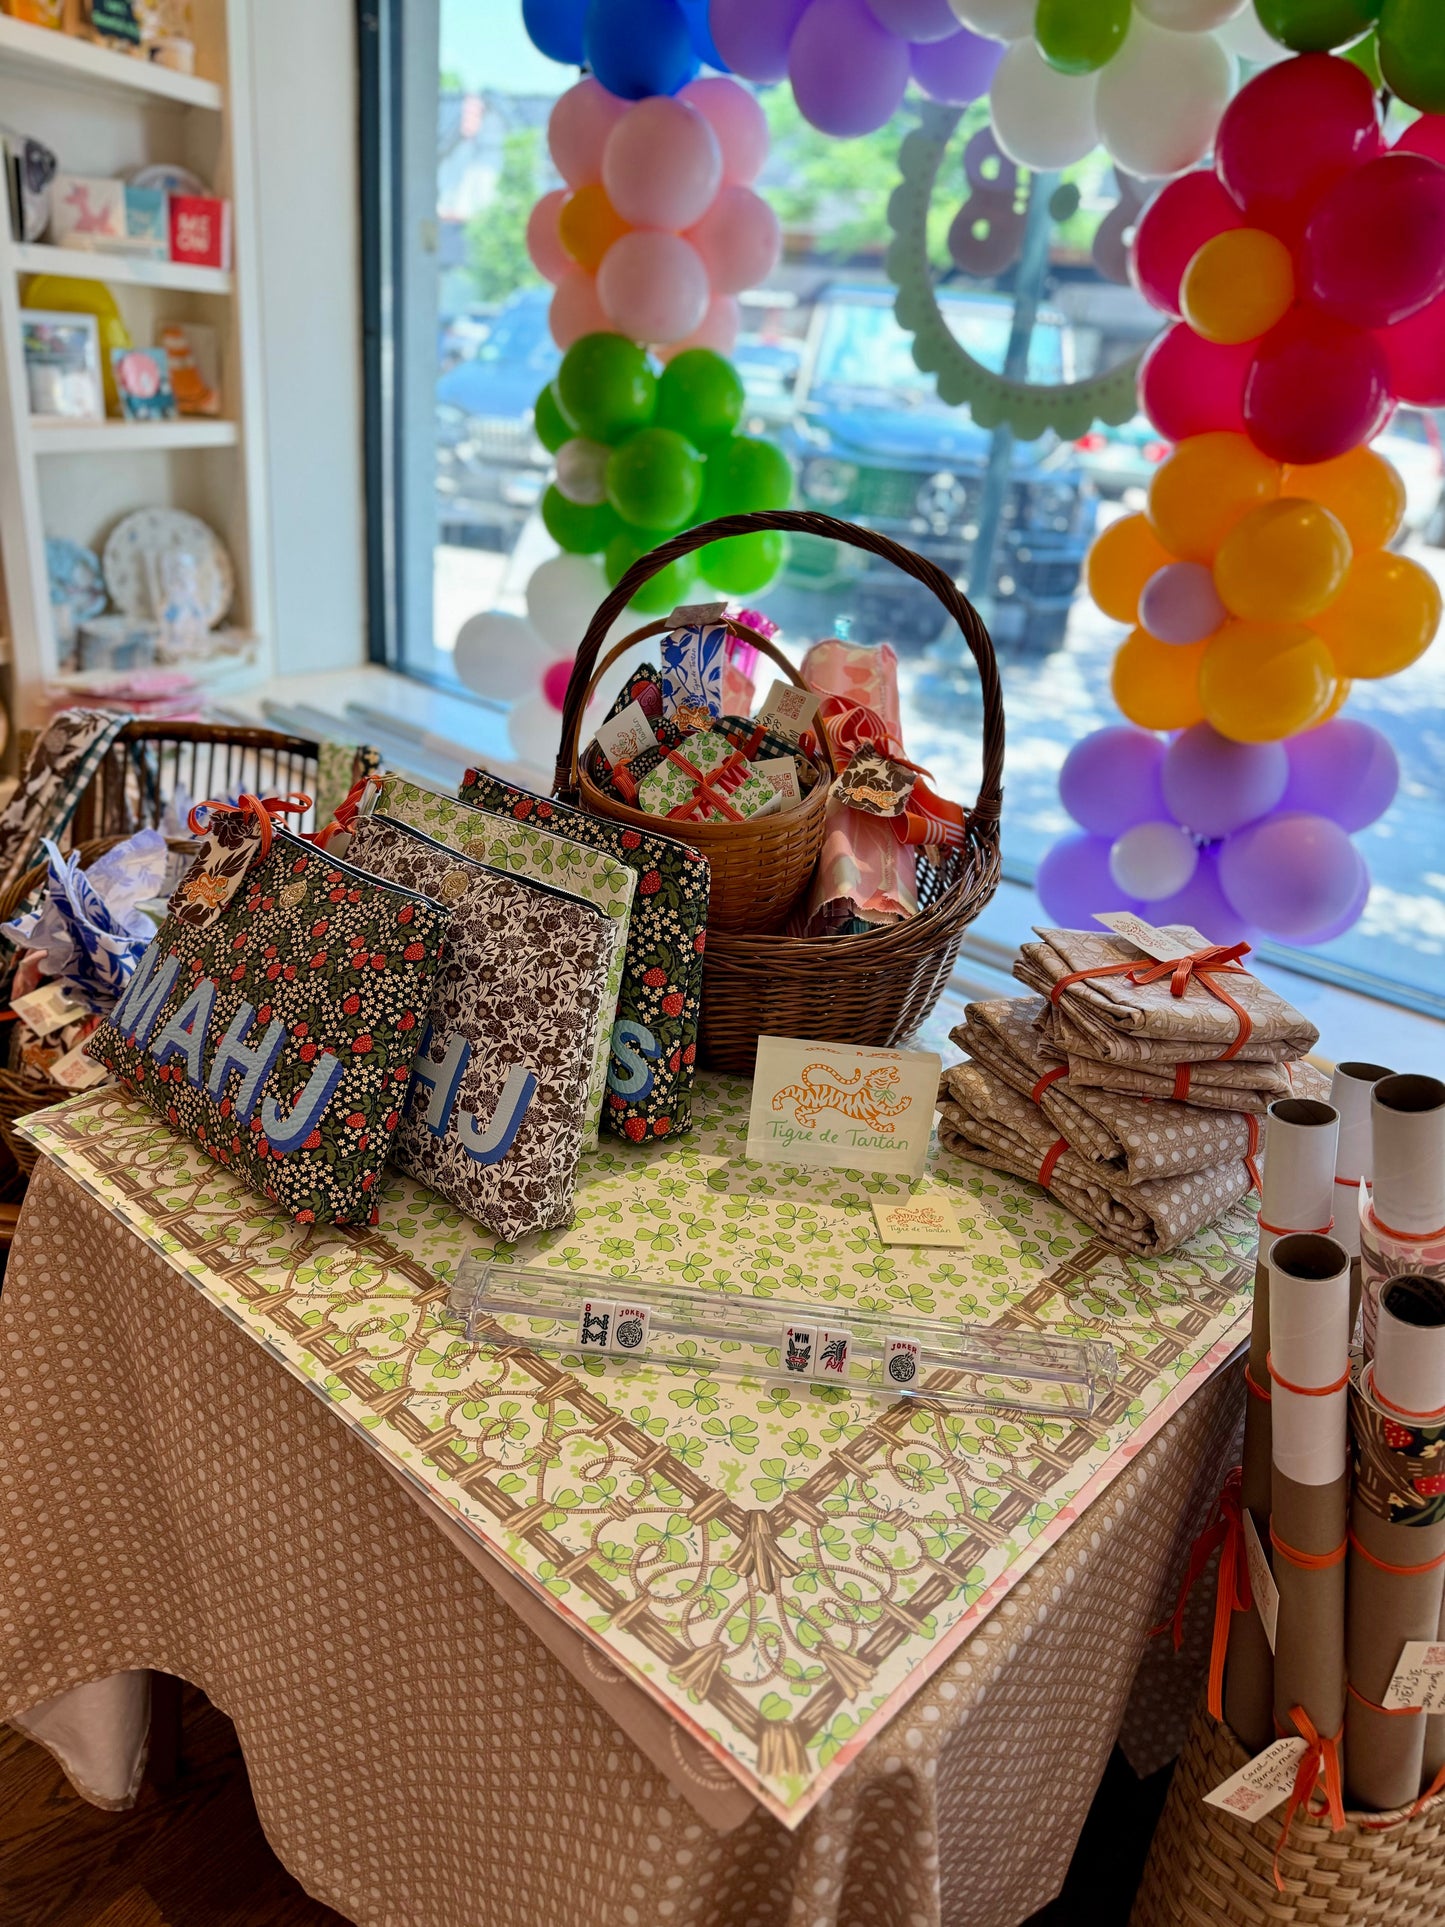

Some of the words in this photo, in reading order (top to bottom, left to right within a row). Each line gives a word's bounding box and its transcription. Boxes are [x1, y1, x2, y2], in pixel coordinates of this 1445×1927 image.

[109, 944, 343, 1153] MAHJ
[766, 1120, 812, 1148] Tigre
[819, 1128, 839, 1145] de
[845, 1128, 909, 1151] Tartán
[887, 1224, 909, 1234] Tigre
[585, 1303, 592, 1312] 8
[619, 1308, 646, 1320] JOKER
[787, 1328, 793, 1337] 4
[794, 1332, 810, 1344] WIN
[824, 1333, 829, 1342] 1
[890, 1341, 917, 1354] JOKER
